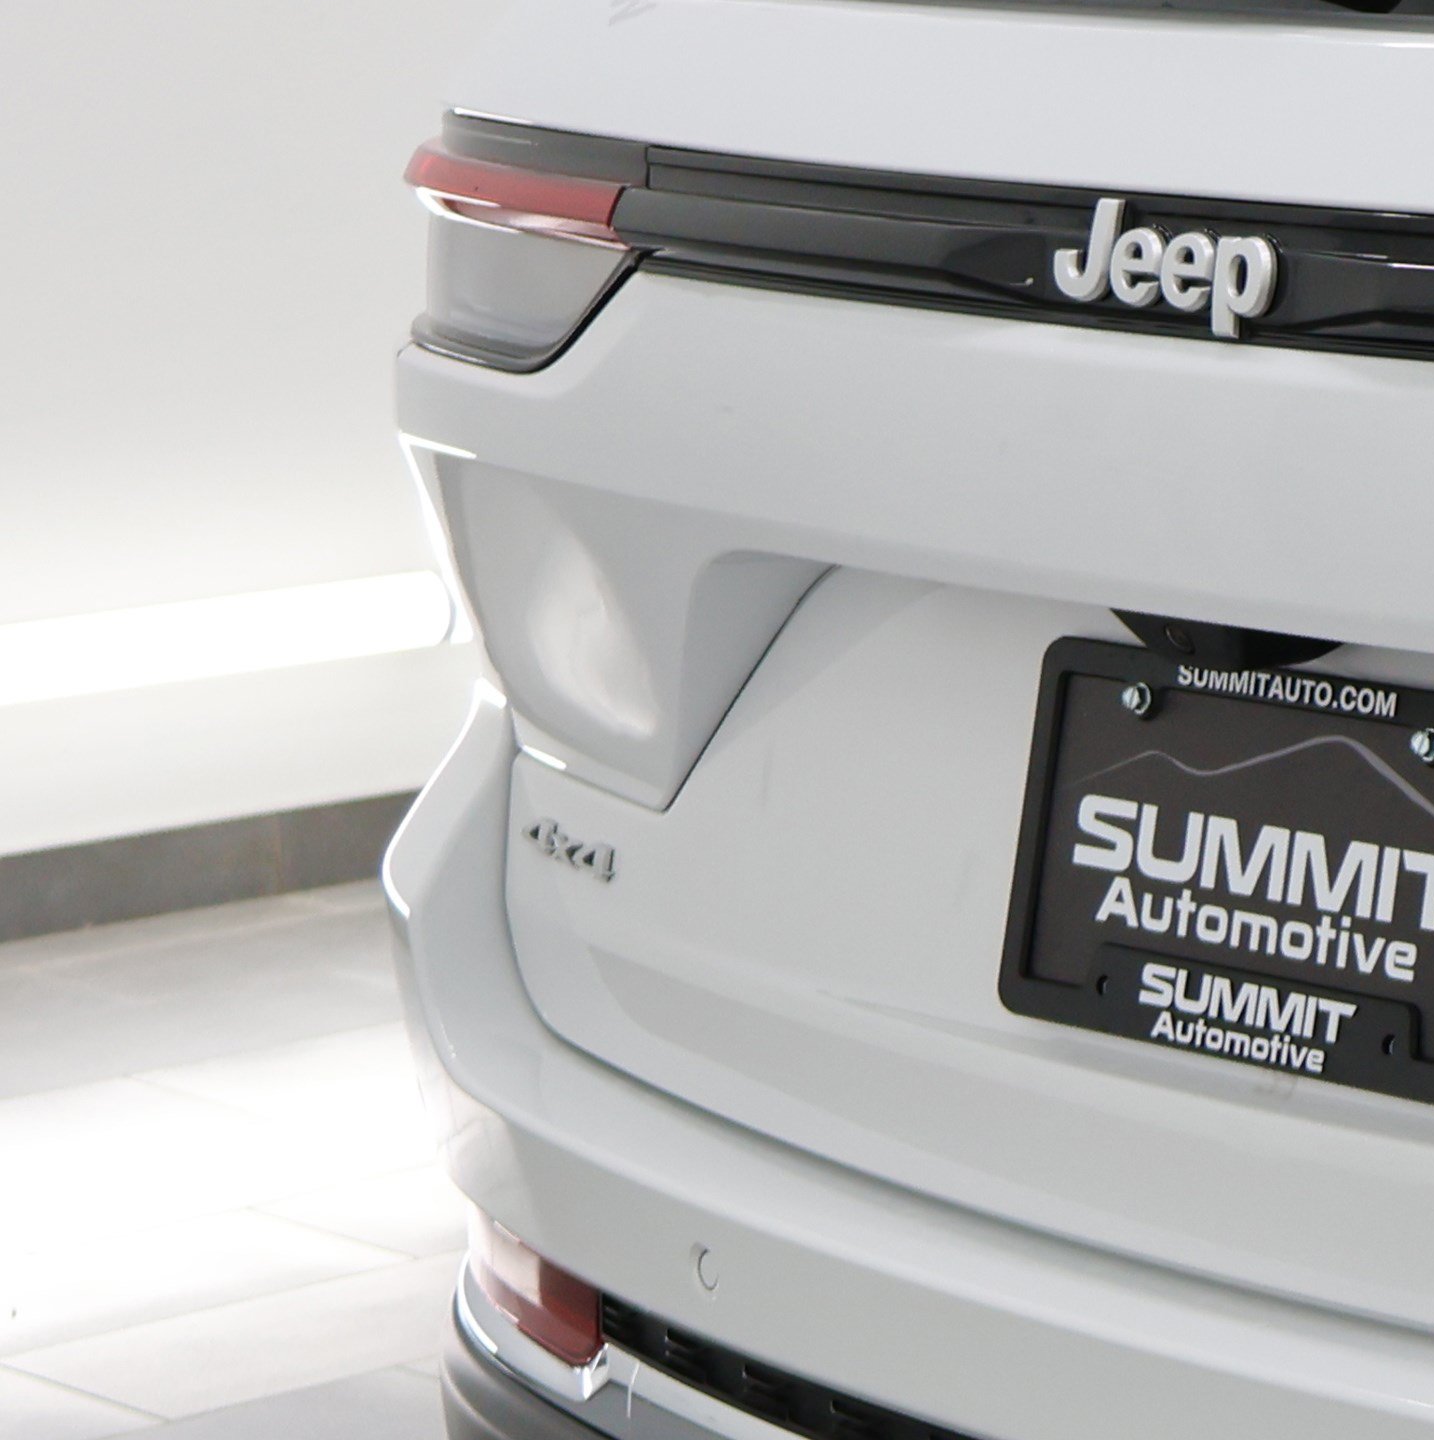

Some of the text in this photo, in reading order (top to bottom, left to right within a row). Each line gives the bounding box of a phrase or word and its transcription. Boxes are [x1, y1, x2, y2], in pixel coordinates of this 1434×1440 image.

[1054, 197, 1279, 339] Jeep
[1177, 663, 1398, 718] SUMMITAUTO.COM
[1095, 875, 1418, 982] Automotive
[1138, 961, 1357, 1043] SUMMIT
[1150, 1009, 1326, 1074] Automotive
